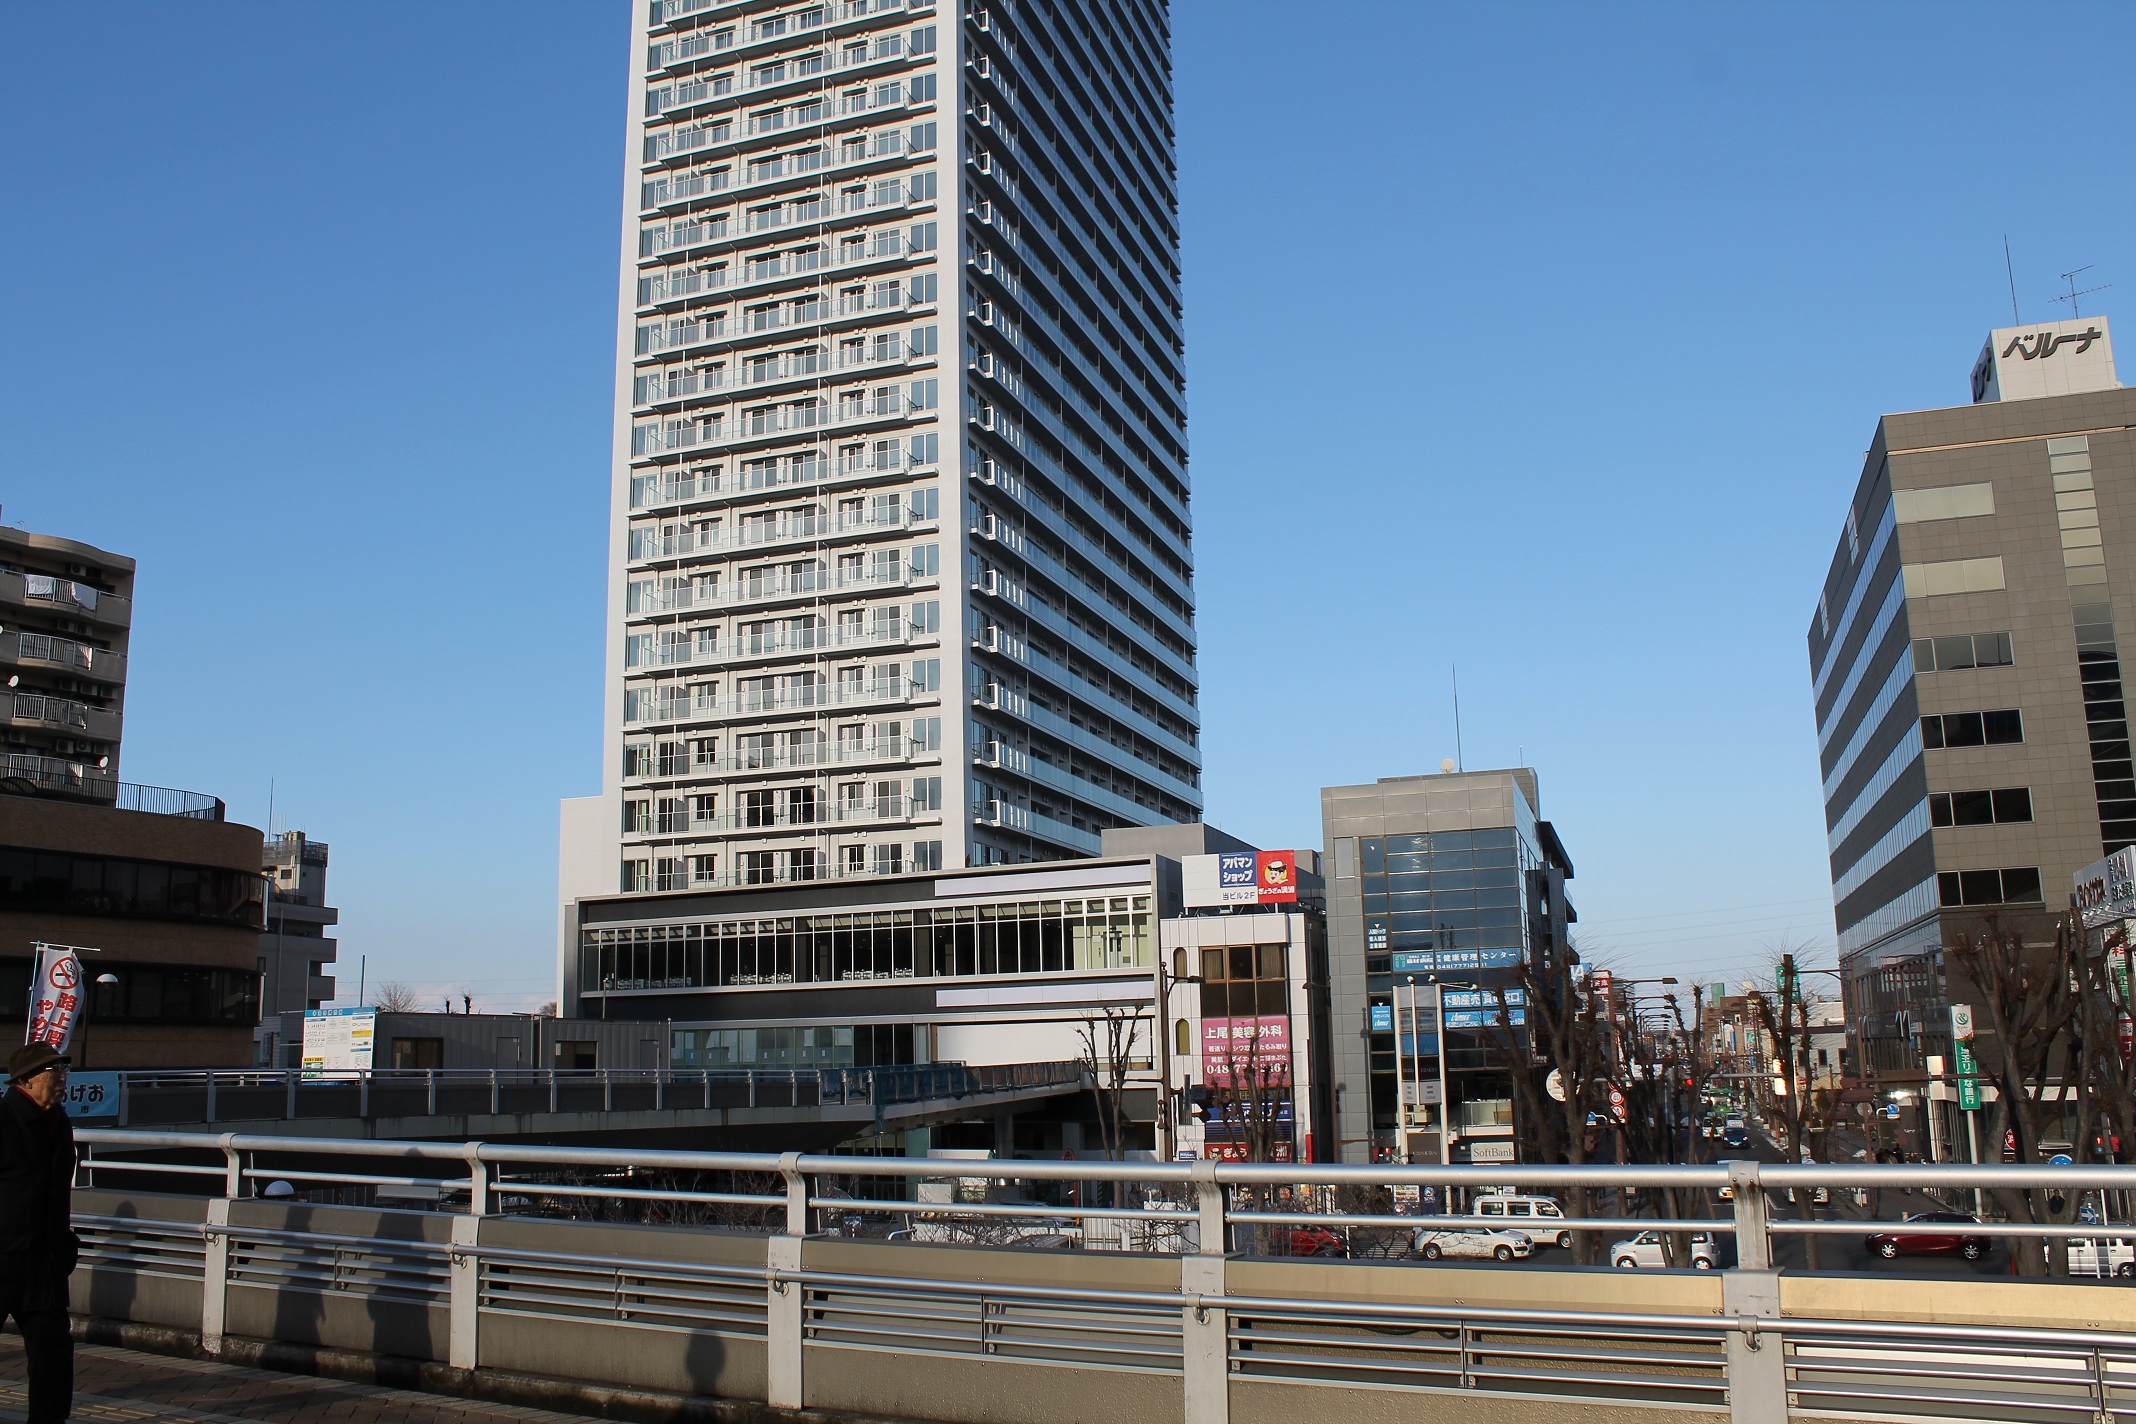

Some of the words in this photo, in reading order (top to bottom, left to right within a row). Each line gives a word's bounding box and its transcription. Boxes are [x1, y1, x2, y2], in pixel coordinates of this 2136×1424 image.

[2001, 326, 2102, 361] ベルーナ
[1222, 856, 1253, 869] アパマン
[1222, 869, 1254, 883] ショップ
[1473, 1147, 1514, 1158] SoftBank
